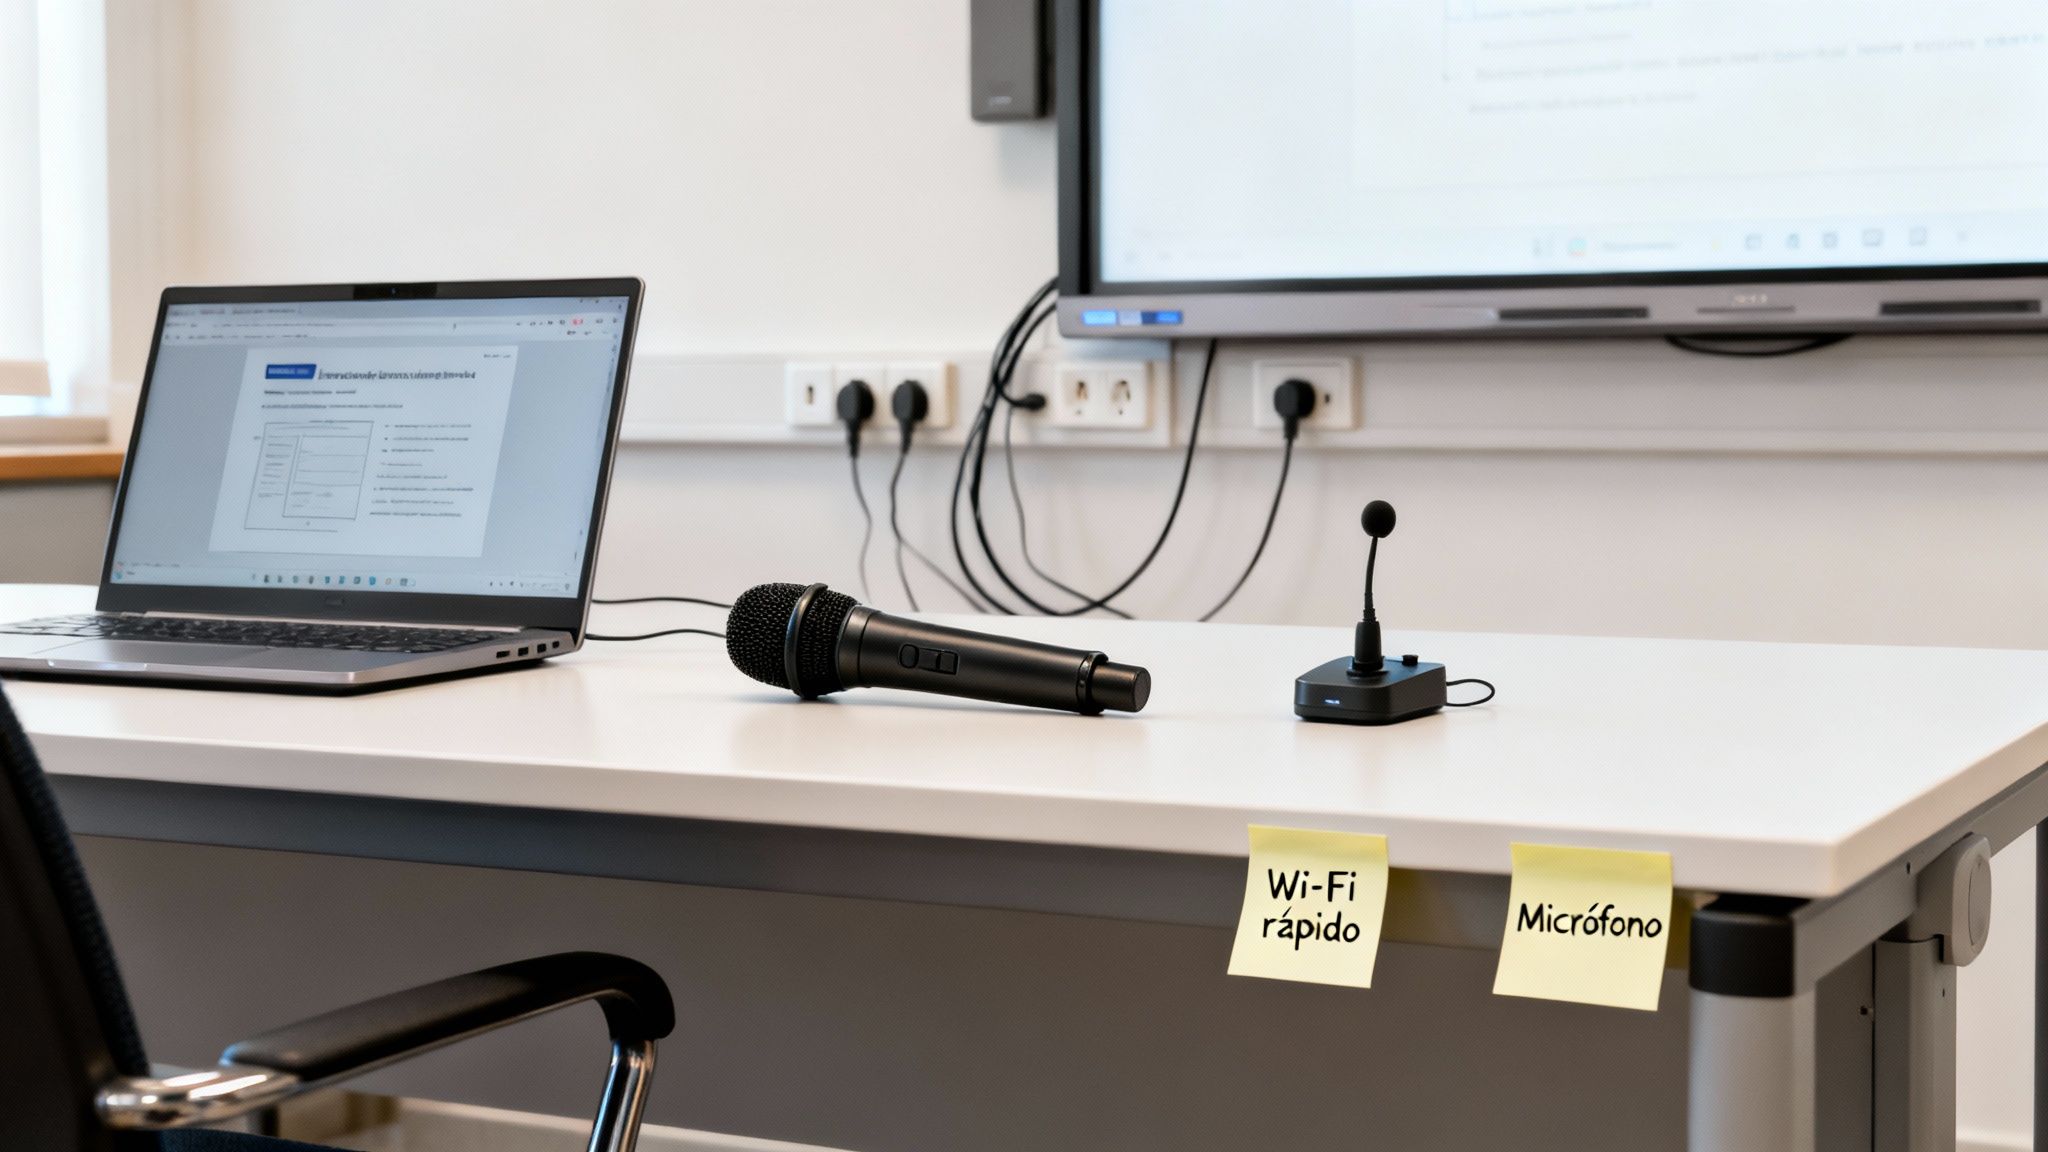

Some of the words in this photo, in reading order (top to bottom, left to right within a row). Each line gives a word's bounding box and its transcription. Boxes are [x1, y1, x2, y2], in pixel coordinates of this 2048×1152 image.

[1268, 868, 1357, 902] Wi-Fi
[1262, 907, 1360, 951] rápido
[1517, 902, 1663, 938] Micrófono
